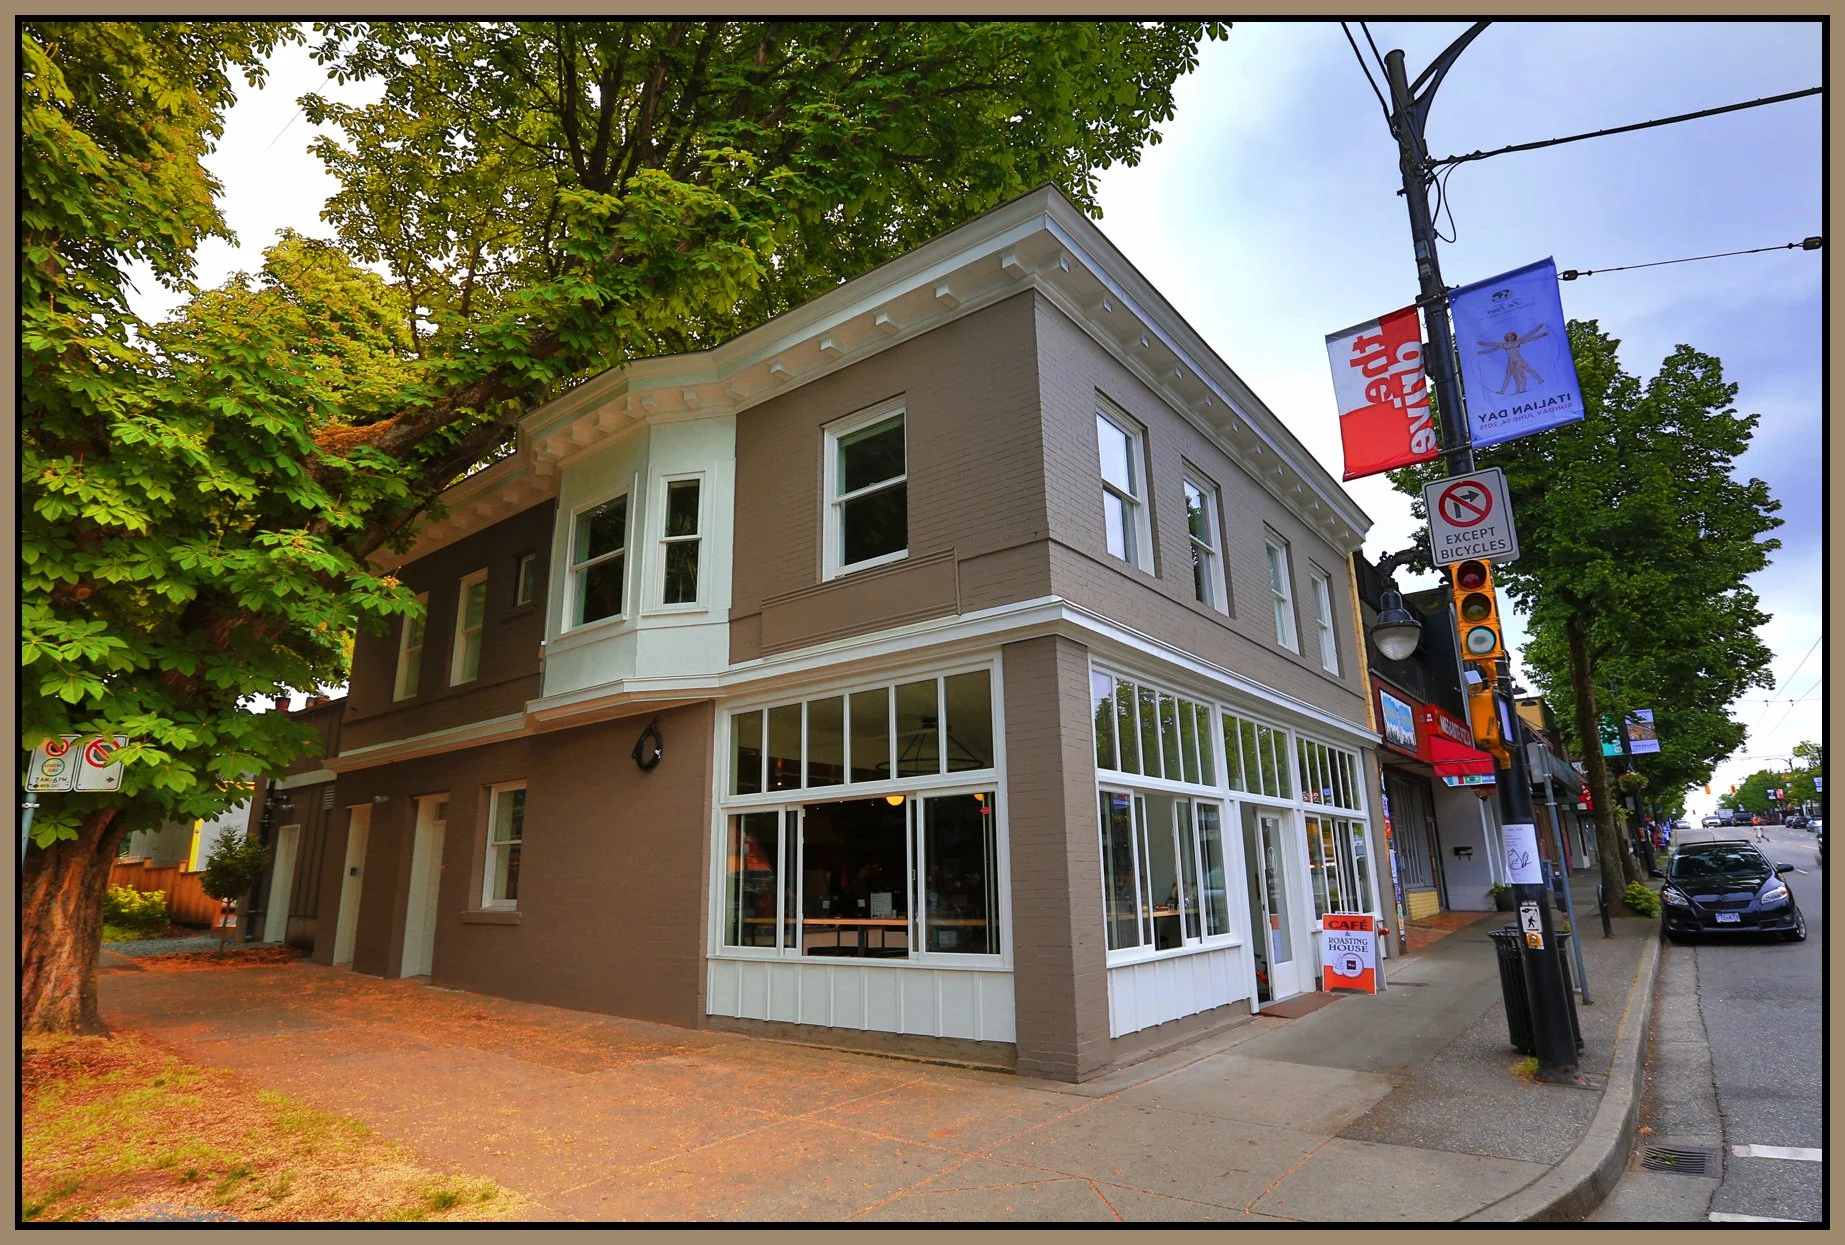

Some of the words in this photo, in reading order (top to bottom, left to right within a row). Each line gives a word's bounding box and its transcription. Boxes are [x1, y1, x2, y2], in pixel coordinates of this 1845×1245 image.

[1446, 527, 1496, 545] EXCEPT
[1441, 539, 1506, 560] BICYCLES
[1328, 919, 1368, 930] CAFÉ
[1328, 937, 1368, 945] ROASTING
[1328, 944, 1368, 952] HOUSE
